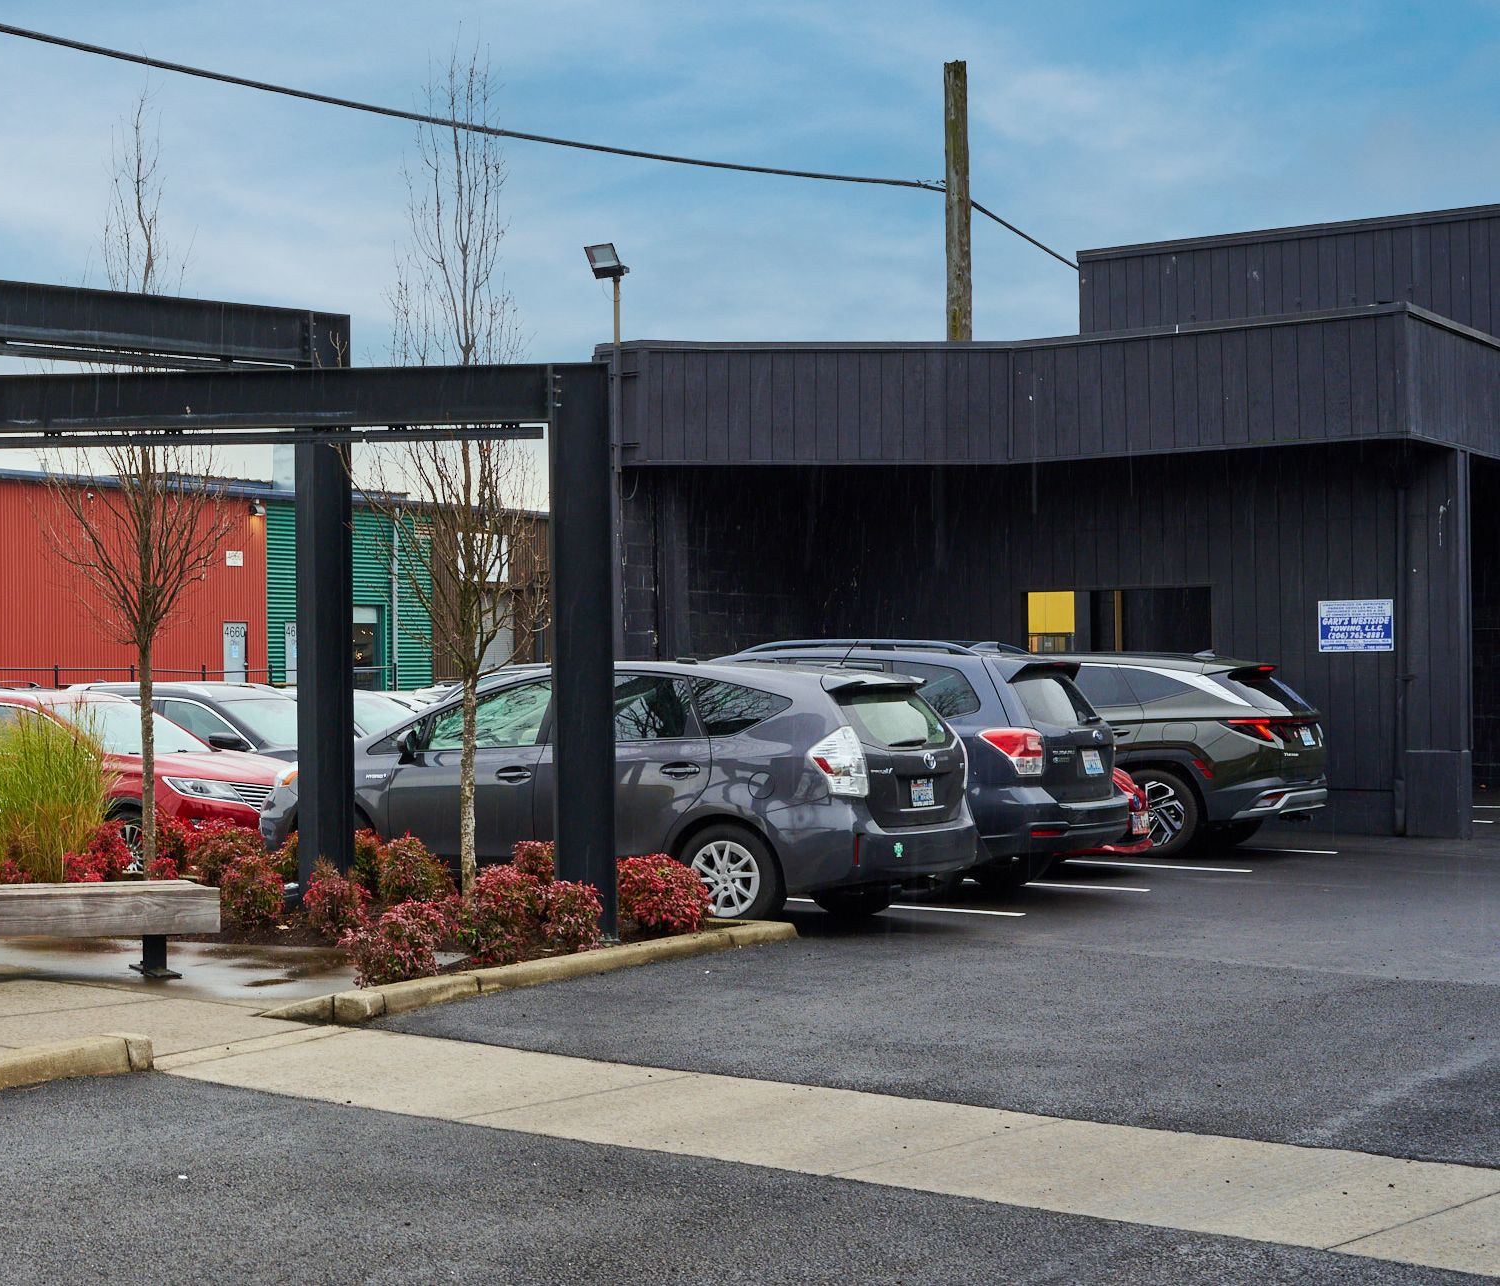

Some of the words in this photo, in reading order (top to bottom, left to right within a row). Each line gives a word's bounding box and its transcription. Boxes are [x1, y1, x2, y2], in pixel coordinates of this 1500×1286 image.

[1322, 617, 1349, 625] GARY'S
[1351, 616, 1390, 624] WESTSIDE
[224, 626, 246, 638] 4660
